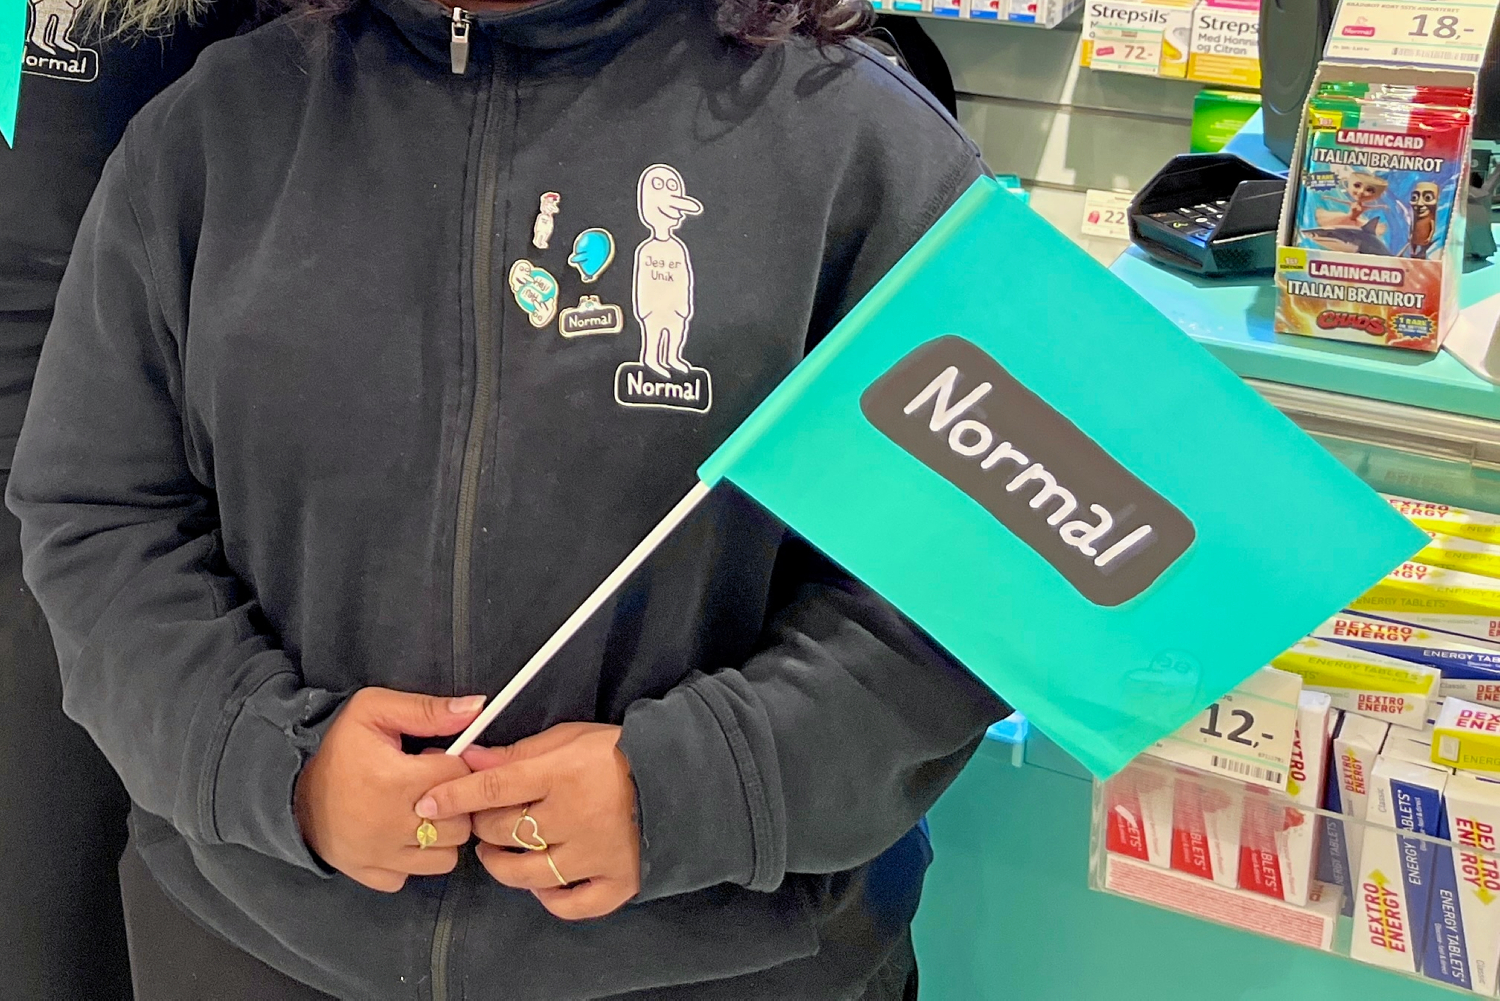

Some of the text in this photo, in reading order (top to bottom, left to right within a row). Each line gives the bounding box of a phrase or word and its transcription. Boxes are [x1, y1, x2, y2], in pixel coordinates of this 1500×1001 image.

[1091, 4, 1168, 24] Strepsils
[1199, 33, 1222, 42] Med
[1197, 43, 1247, 55] og Citron
[1337, 130, 1424, 149] LAMINCARD
[1313, 148, 1443, 172] ITALIAN BRAINROT
[645, 256, 681, 269] Jeg er
[651, 270, 674, 282] Unik
[1310, 262, 1402, 284] LAMINCARD
[1287, 280, 1424, 308] ITALIAN BRAINROT
[569, 313, 612, 328] Normal
[1317, 310, 1386, 336] CHAOS
[627, 371, 700, 400] Normal
[903, 366, 1152, 566] Normal
[1333, 628, 1412, 642] ENERGY
[1335, 619, 1412, 635] DEXTRO
[1308, 657, 1360, 670] ENERGY
[1423, 649, 1474, 660] ENERGY
[1358, 694, 1404, 705] DEXTRO
[1358, 703, 1404, 714] ENERGY
[1342, 754, 1355, 792] DEXTRO
[1351, 757, 1365, 796] ENERGY
[1363, 882, 1386, 948] DEXTRO
[1439, 889, 1458, 932] ENERGY
[1381, 888, 1406, 953] ENERGY
